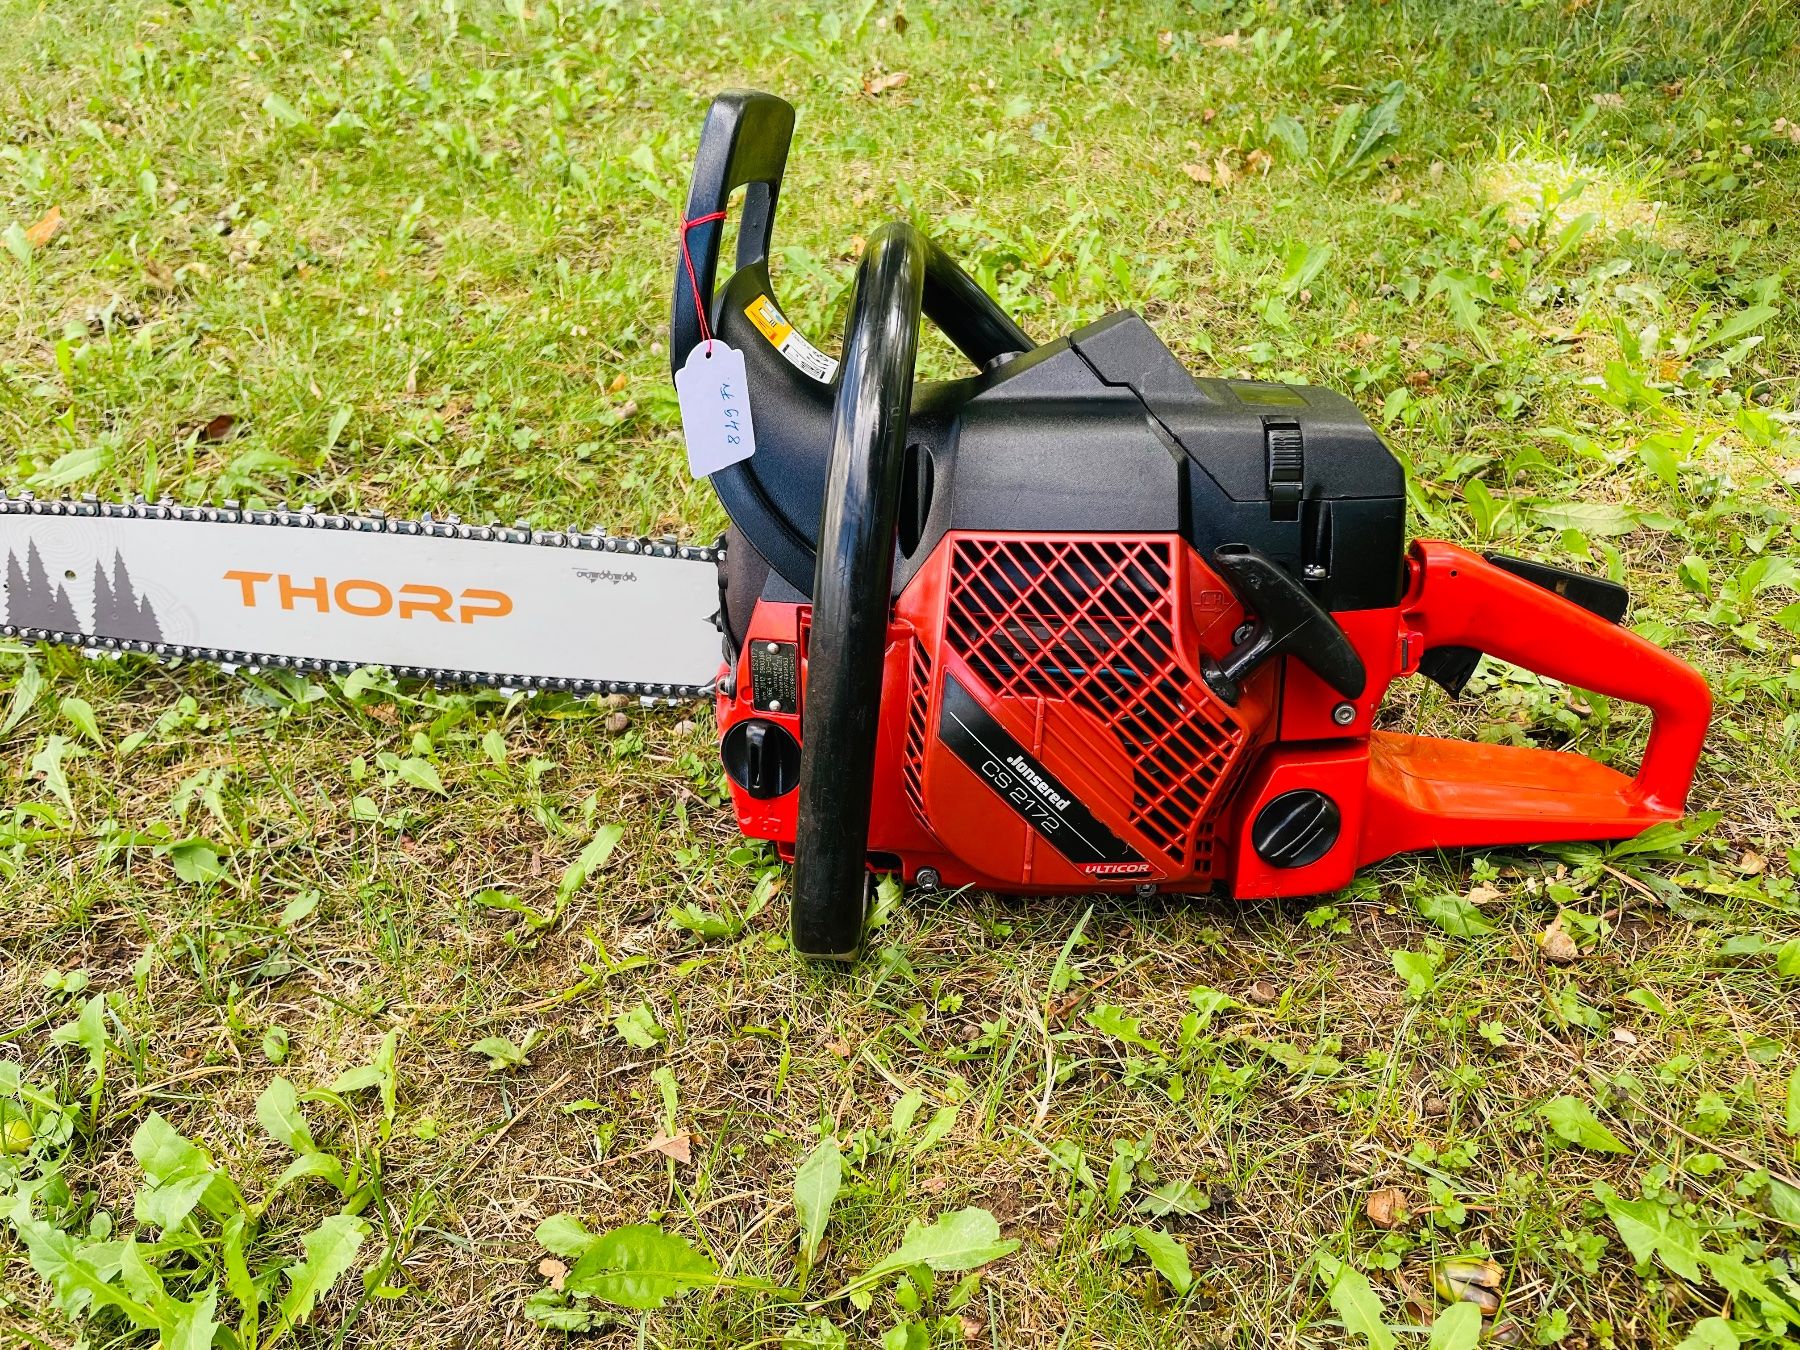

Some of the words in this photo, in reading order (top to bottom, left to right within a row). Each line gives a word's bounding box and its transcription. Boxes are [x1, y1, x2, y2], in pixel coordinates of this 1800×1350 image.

[223, 570, 514, 624] THORP
[982, 760, 1012, 788] CS
[1009, 787, 1060, 833] 2172
[1006, 755, 1071, 811] Jonsered
